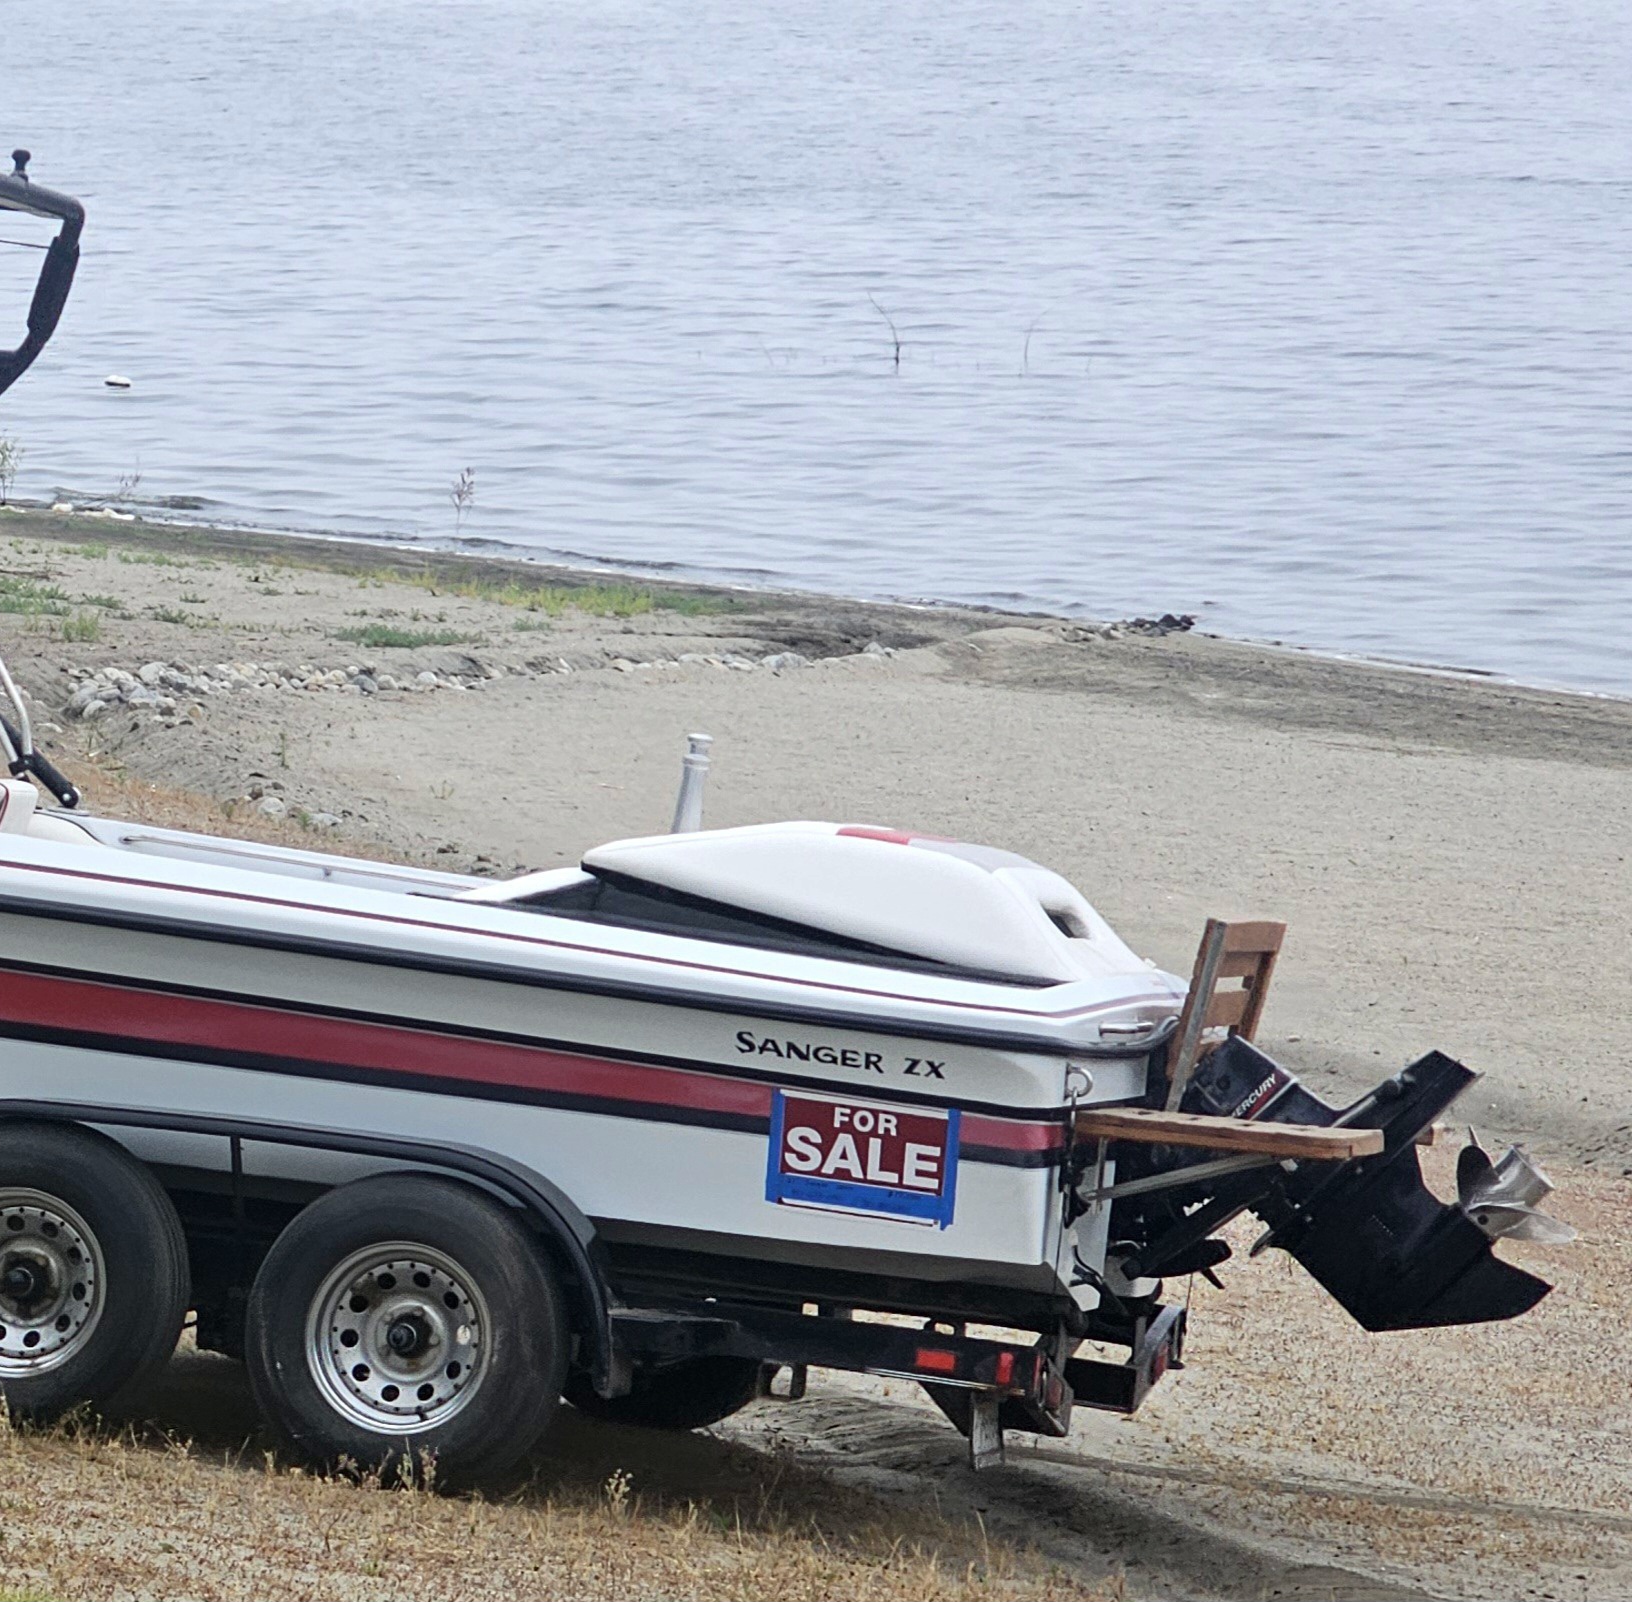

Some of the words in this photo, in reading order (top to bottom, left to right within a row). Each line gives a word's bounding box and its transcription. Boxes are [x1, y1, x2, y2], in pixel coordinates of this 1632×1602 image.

[735, 1031, 884, 1074] SANGER
[903, 1057, 946, 1080] ZX
[833, 1106, 898, 1137] FOR
[784, 1126, 941, 1189] SALE
